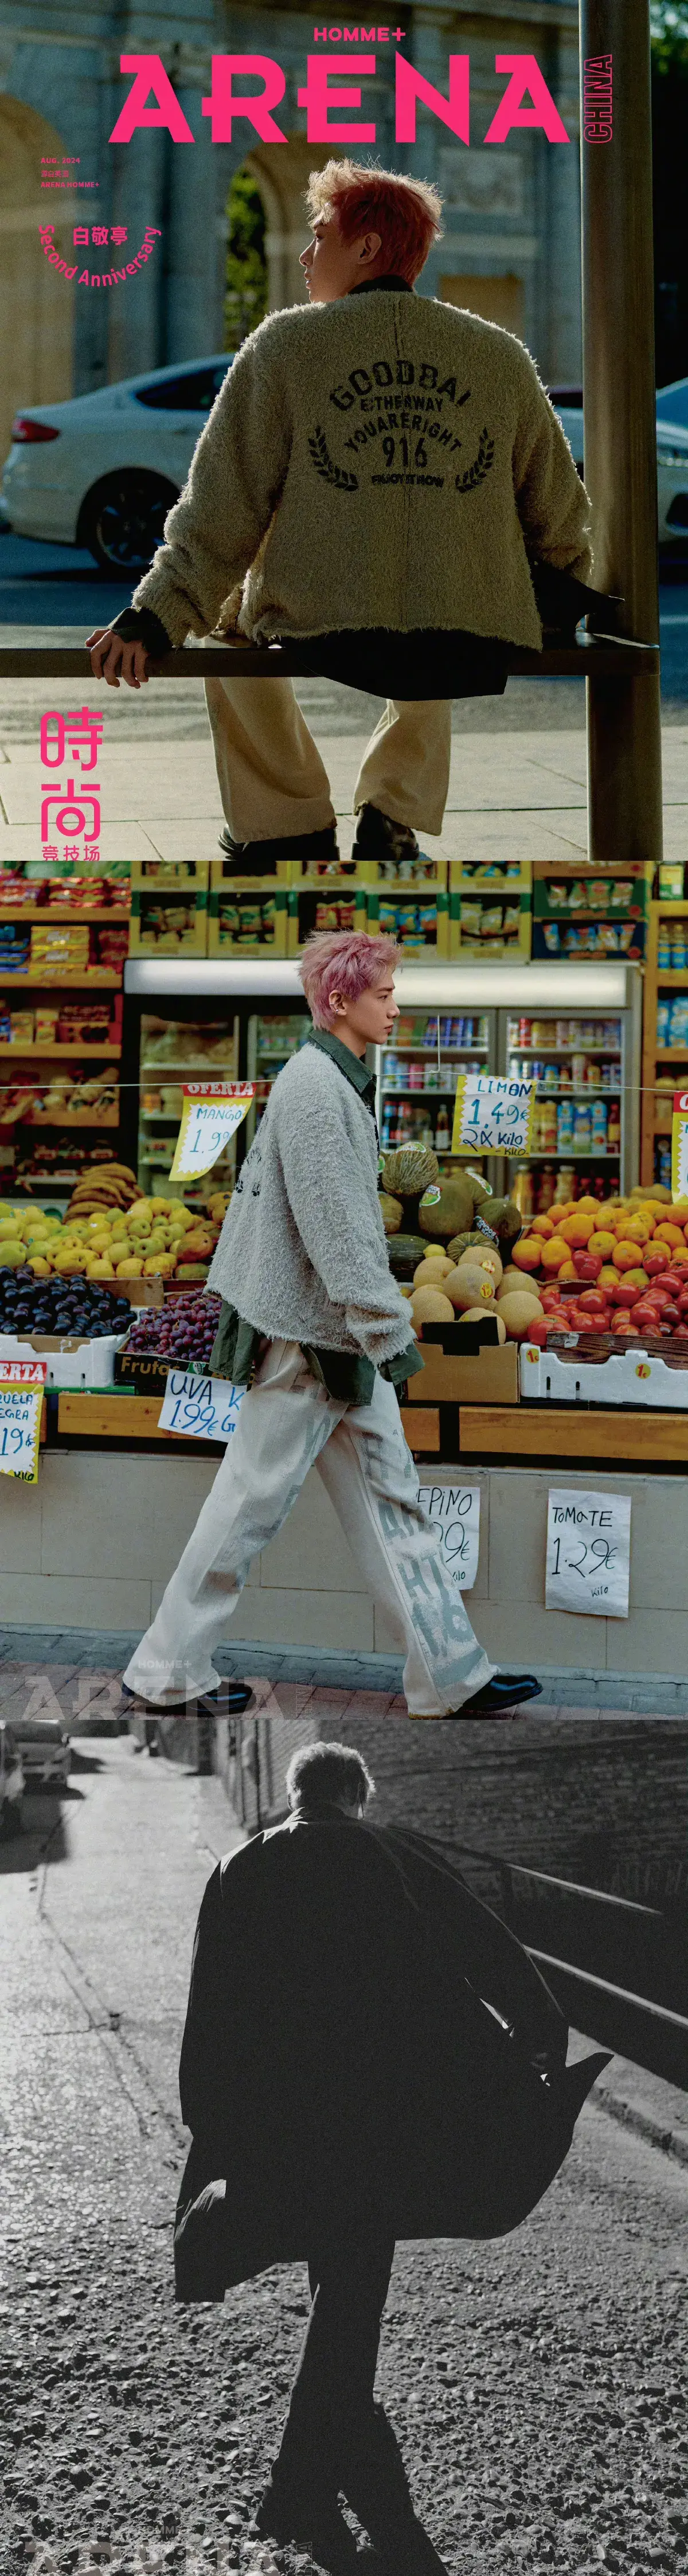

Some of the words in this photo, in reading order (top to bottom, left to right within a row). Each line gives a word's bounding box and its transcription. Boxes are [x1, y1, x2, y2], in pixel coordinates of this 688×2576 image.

[330, 360, 471, 411] GOODBAI
[382, 436, 428, 468] 916
[187, 1082, 253, 1096] OFERTA
[478, 1079, 533, 1098] LIMON
[196, 1107, 243, 1121] MANGO
[171, 1374, 212, 1405] UVA
[416, 1487, 472, 1516] EPINO
